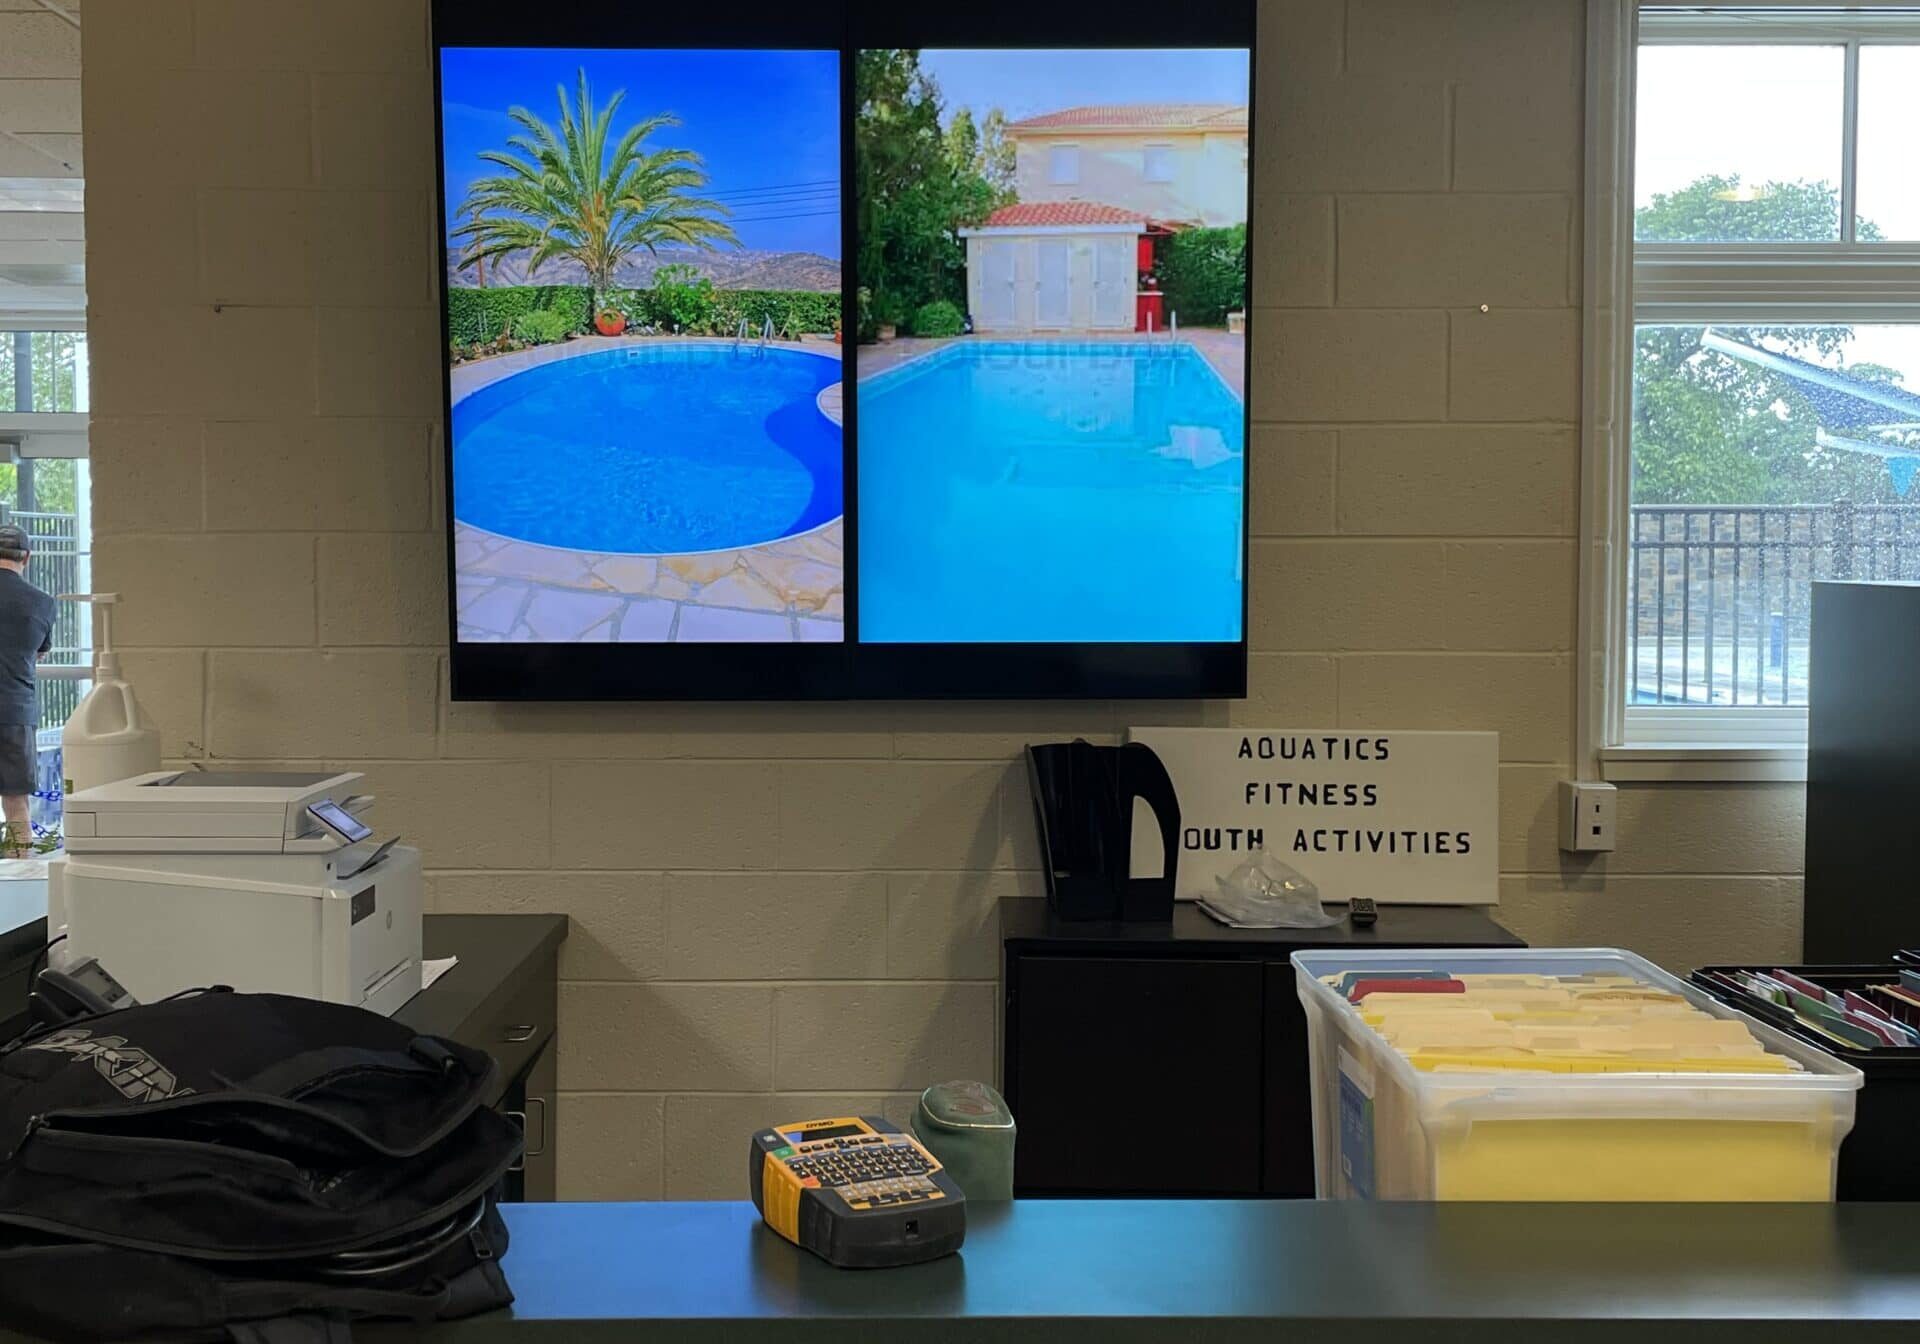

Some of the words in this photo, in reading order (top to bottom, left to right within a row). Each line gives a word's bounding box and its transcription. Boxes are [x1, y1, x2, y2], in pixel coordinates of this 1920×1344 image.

[1238, 736, 1389, 761] AQUATICS
[1245, 782, 1377, 807] FITNESS
[1183, 827, 1264, 852] OUTH
[1293, 828, 1470, 854] ACTIVITIES
[805, 1120, 835, 1129] DYMO
